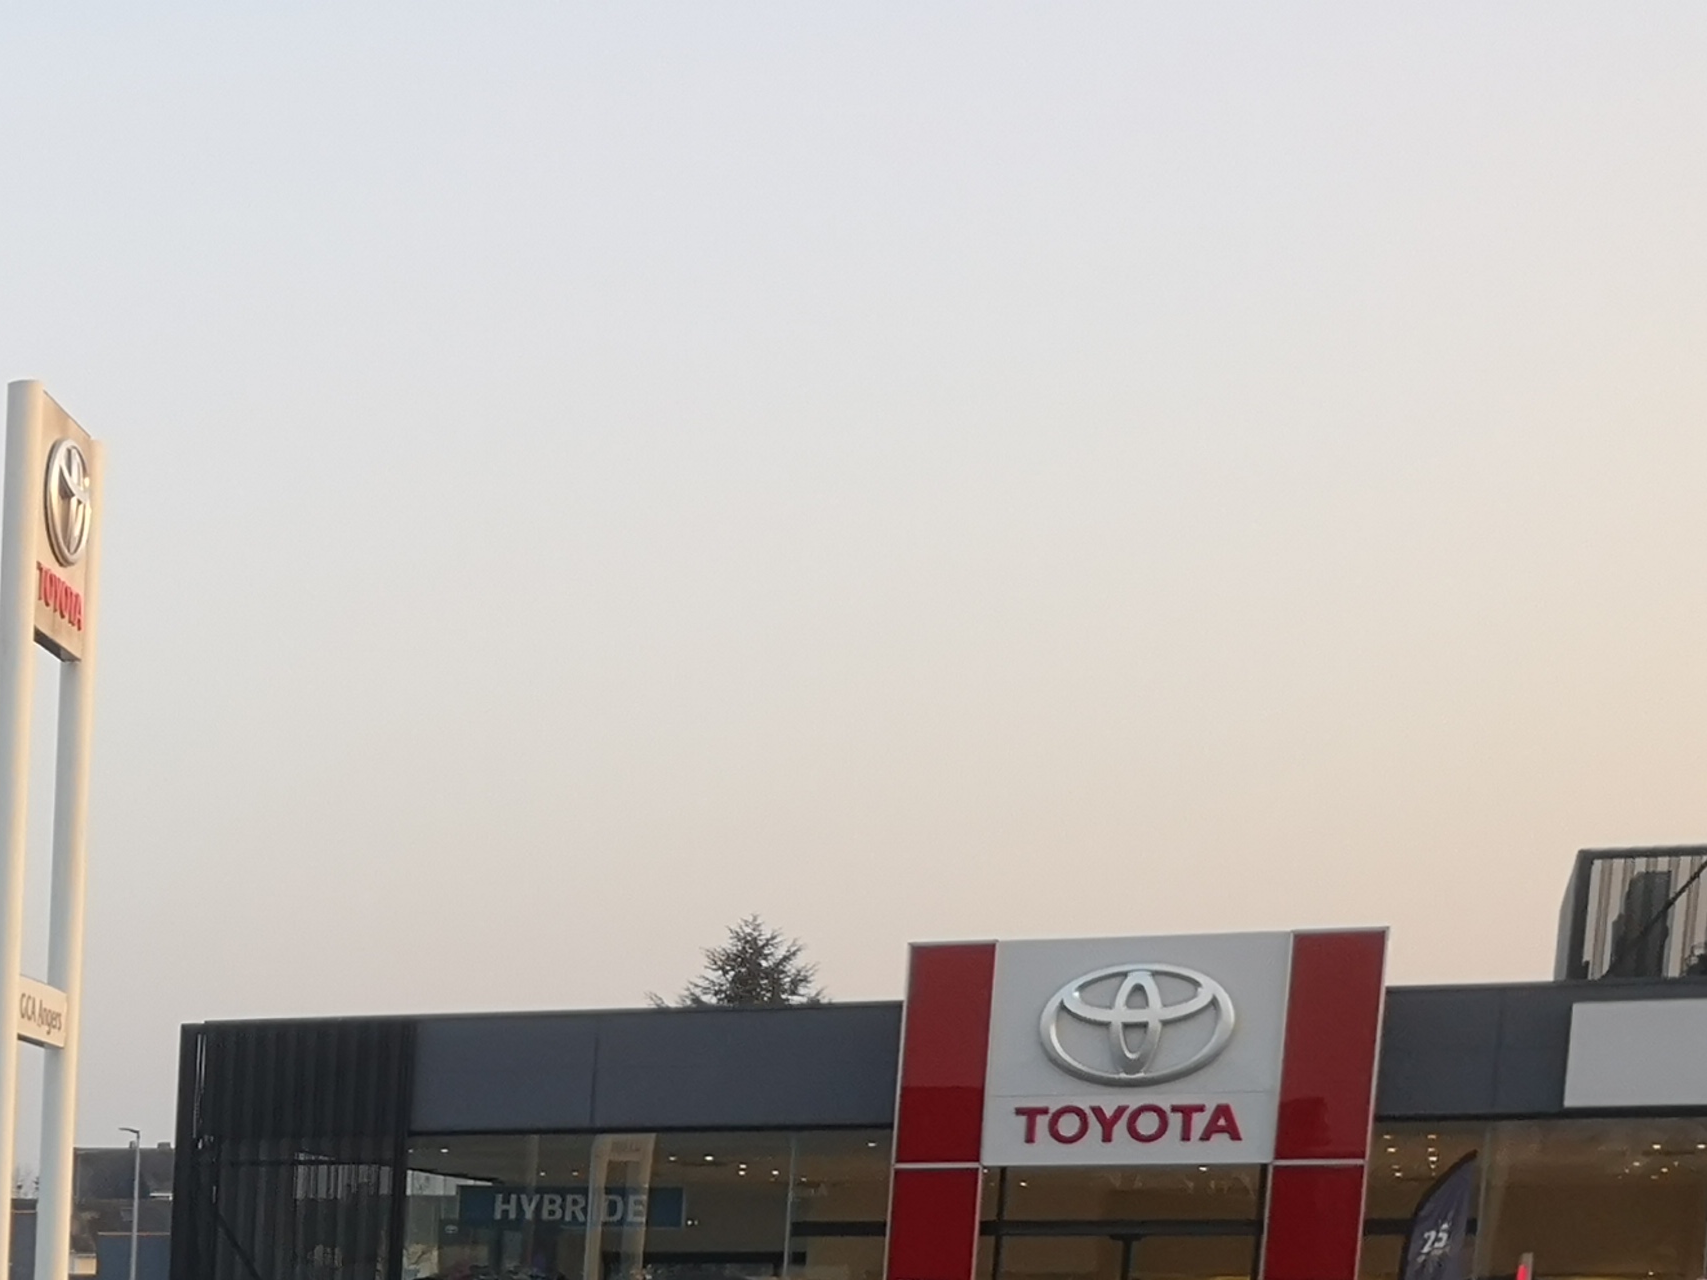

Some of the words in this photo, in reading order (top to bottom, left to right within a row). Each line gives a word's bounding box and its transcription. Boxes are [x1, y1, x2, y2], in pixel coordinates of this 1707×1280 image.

[36, 560, 85, 632] TOYOTA
[1014, 1103, 1243, 1145] TOYOTA
[493, 1193, 649, 1223] HYBRDE
